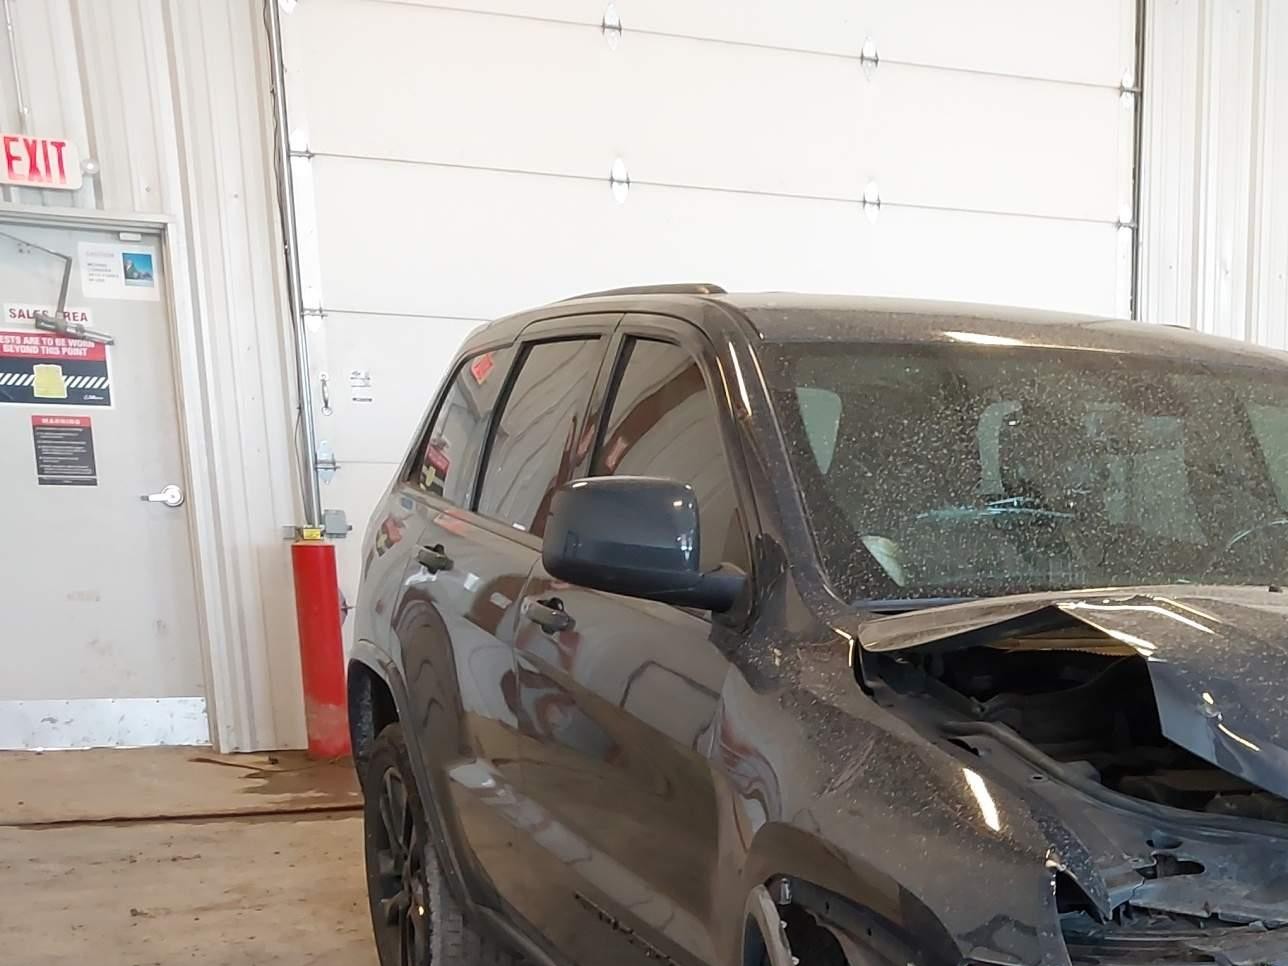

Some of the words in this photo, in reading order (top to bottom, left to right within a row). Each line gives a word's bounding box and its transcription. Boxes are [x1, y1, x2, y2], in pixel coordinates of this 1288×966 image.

[3, 135, 67, 184] EXIT
[63, 311, 89, 322] REA
[23, 336, 40, 345] ARE
[41, 337, 53, 346] TO
[3, 344, 39, 354] BEYOND
[41, 346, 60, 355] THIS
[62, 347, 88, 356] POINT
